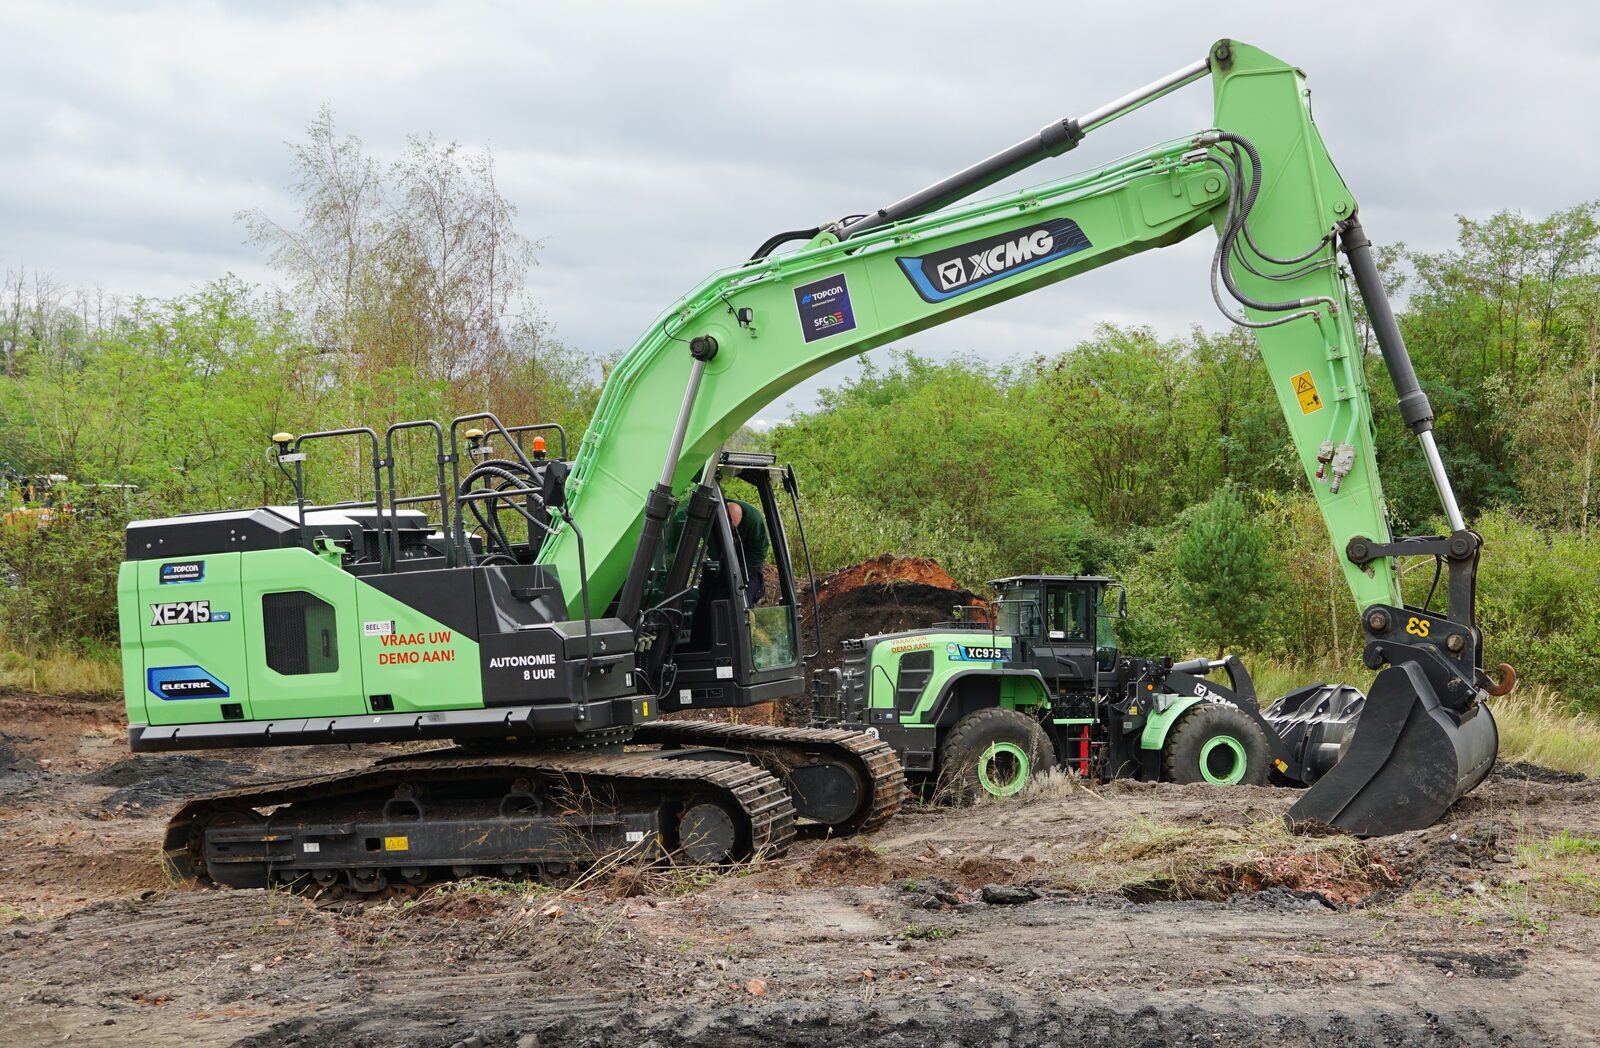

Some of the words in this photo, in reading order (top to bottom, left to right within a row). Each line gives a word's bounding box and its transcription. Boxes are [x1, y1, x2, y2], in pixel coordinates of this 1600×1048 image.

[968, 230, 1054, 281] XCMG
[812, 286, 844, 301] TOPCON
[813, 316, 829, 327] SFC
[173, 564, 199, 574] TOPCON
[150, 601, 211, 626] XE215
[380, 632, 425, 647] VRAAG
[428, 631, 452, 645] UW
[891, 637, 915, 645] VRAAG
[891, 643, 912, 654] DEMO
[913, 642, 931, 651] AAN!
[968, 648, 1002, 659] XC975
[378, 651, 420, 665] DEMO
[422, 649, 455, 663] AAN!
[489, 653, 557, 668] AUTONOMIE
[523, 670, 531, 681] 8
[532, 668, 556, 680] UUR
[161, 681, 211, 691] ELECTRIC
